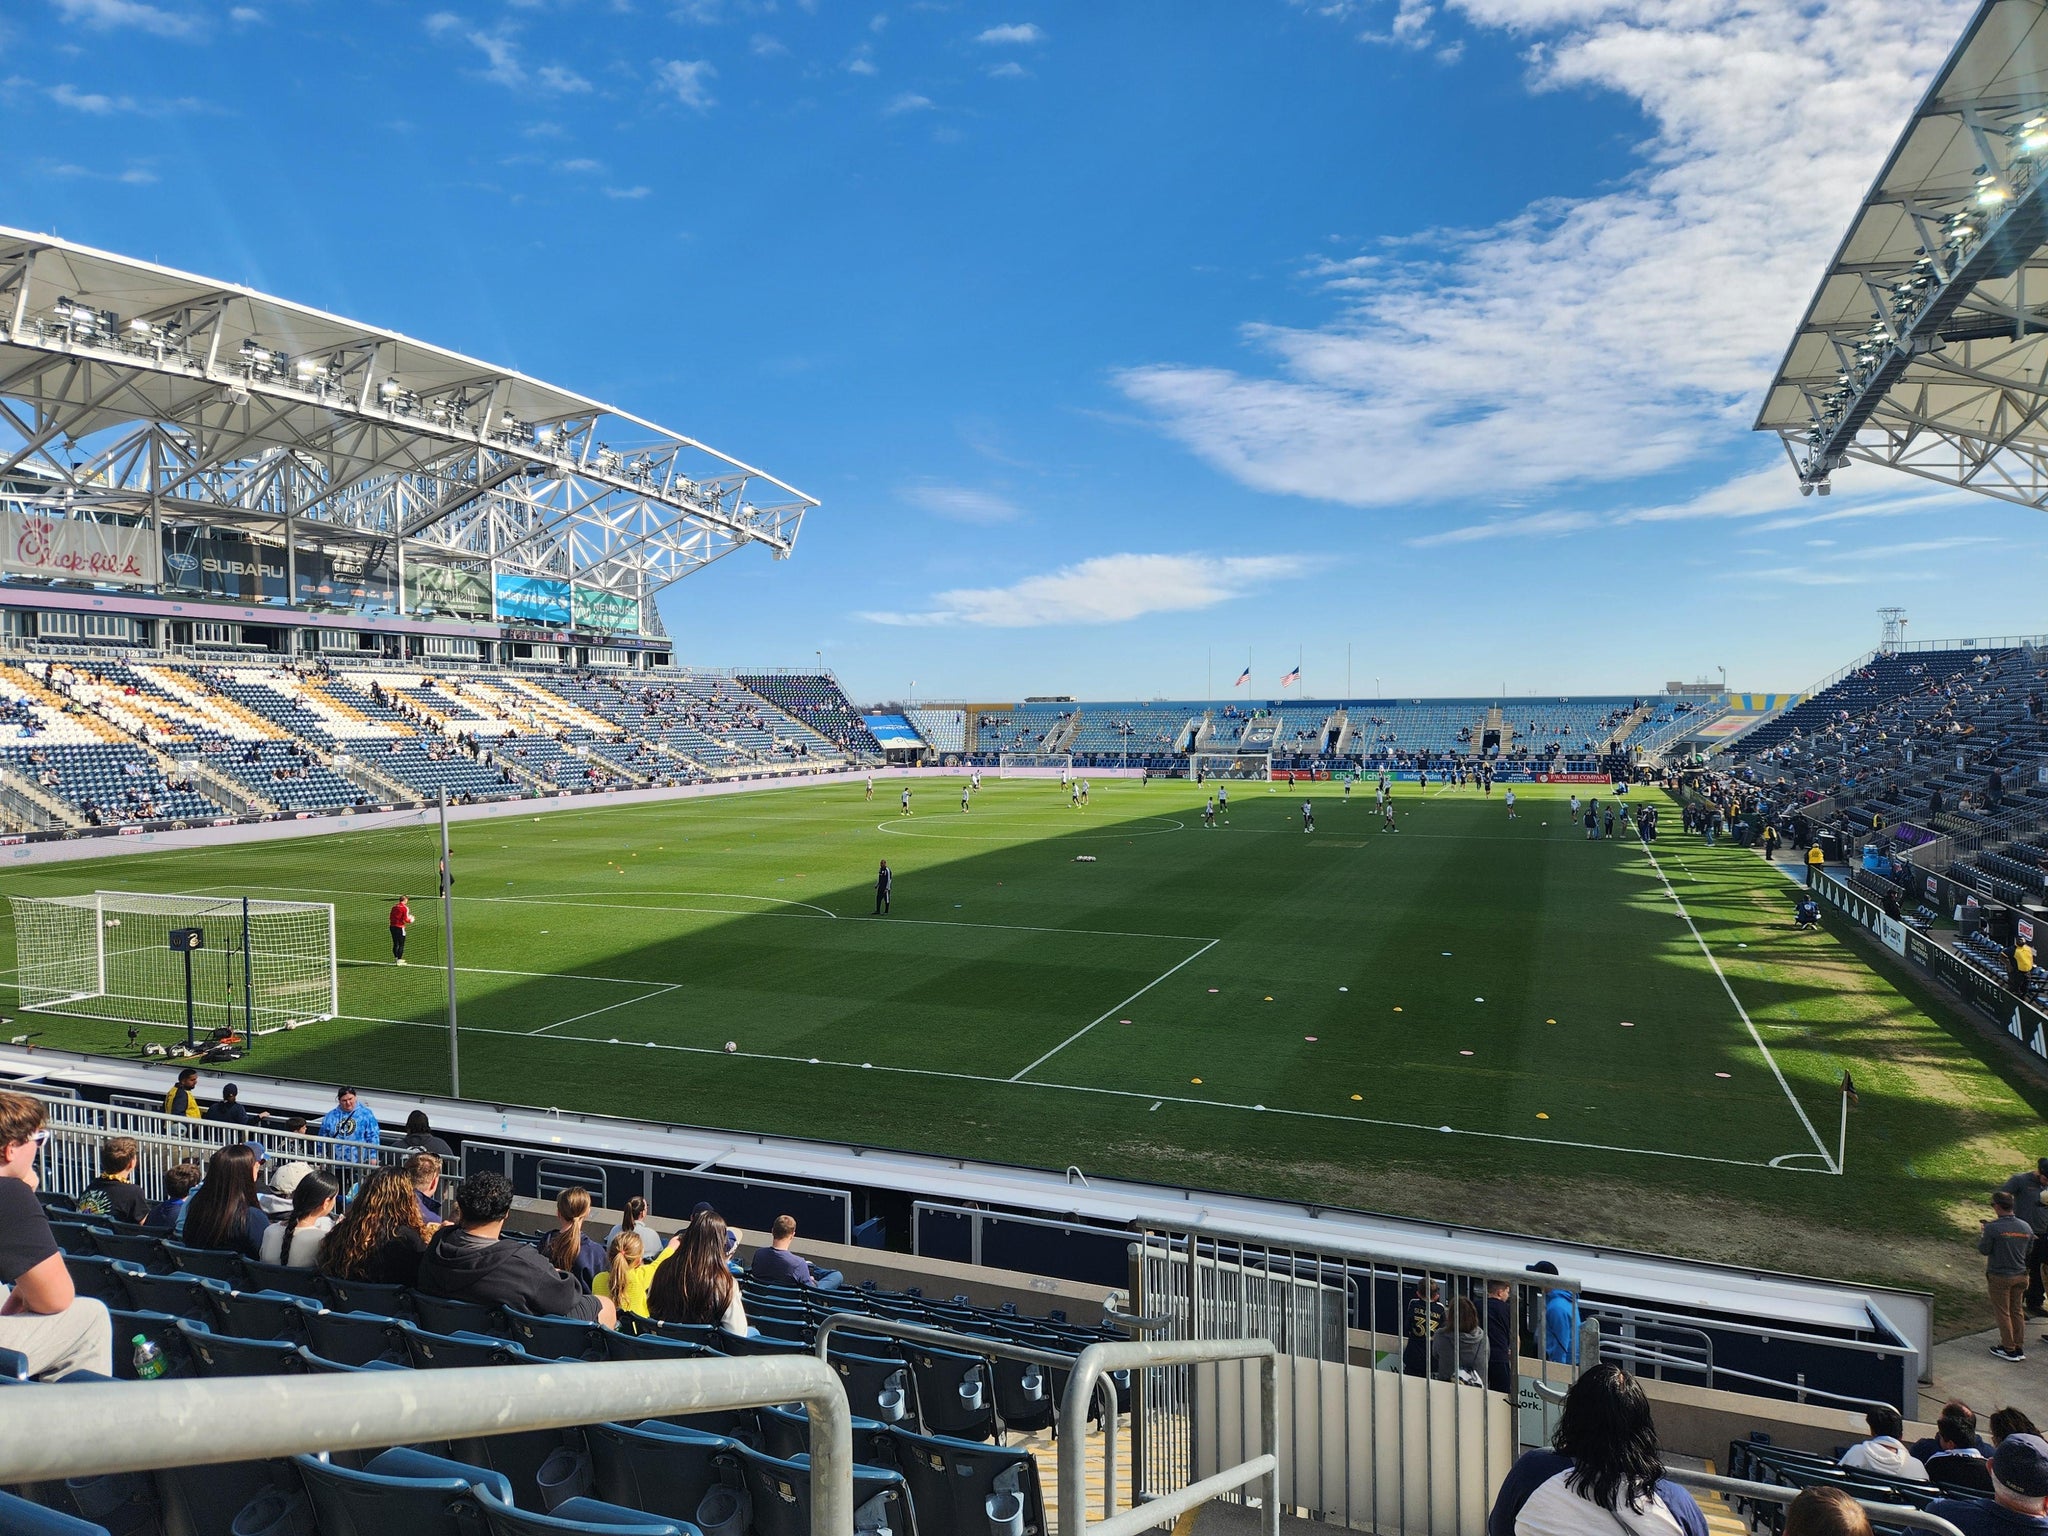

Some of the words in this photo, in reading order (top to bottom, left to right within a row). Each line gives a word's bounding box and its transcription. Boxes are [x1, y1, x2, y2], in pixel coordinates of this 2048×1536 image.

[202, 558, 284, 579] SUBARU
[334, 563, 362, 574] BIMBO
[594, 602, 637, 616] NEMOURS
[1935, 948, 1963, 975] SOFITEL
[1969, 971, 2004, 1003] SOFITEL
[1519, 1400, 1543, 1411] ork.
